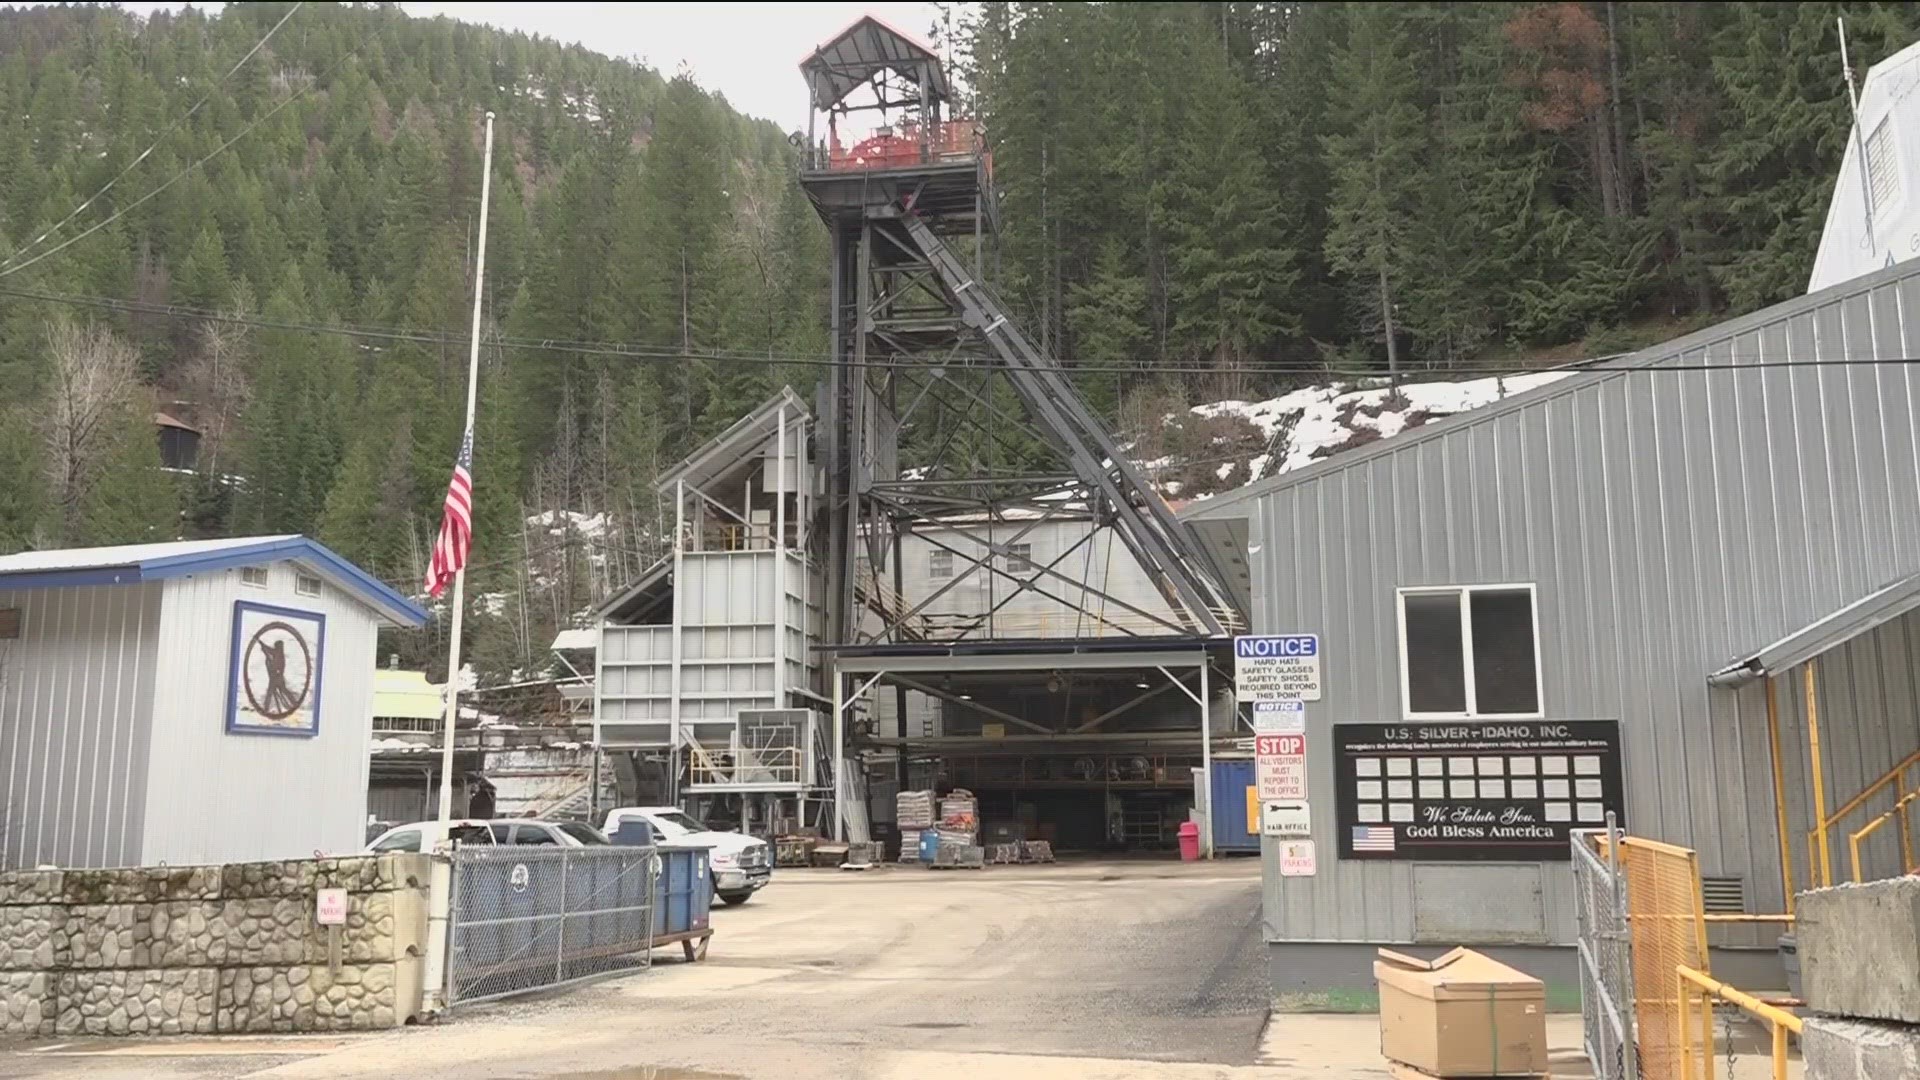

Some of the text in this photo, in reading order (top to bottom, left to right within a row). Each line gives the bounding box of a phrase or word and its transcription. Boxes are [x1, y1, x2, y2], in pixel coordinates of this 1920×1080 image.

[1241, 638, 1314, 656] NOTICE
[1276, 666, 1314, 674] GLASSES
[1247, 674, 1309, 683] SAFETY SHOES
[1258, 702, 1299, 711] NOTICE
[1419, 727, 1470, 740] SILVER
[1541, 725, 1572, 738] INC.
[1260, 738, 1301, 755] STOP
[1272, 757, 1302, 765] VISITORS
[1272, 767, 1291, 775] MUST
[1264, 777, 1289, 785] REPORT
[1277, 787, 1300, 795] OFFICE
[1423, 806, 1448, 822] We
[1450, 806, 1497, 822] Salute
[1406, 824, 1554, 838] God Bless America
